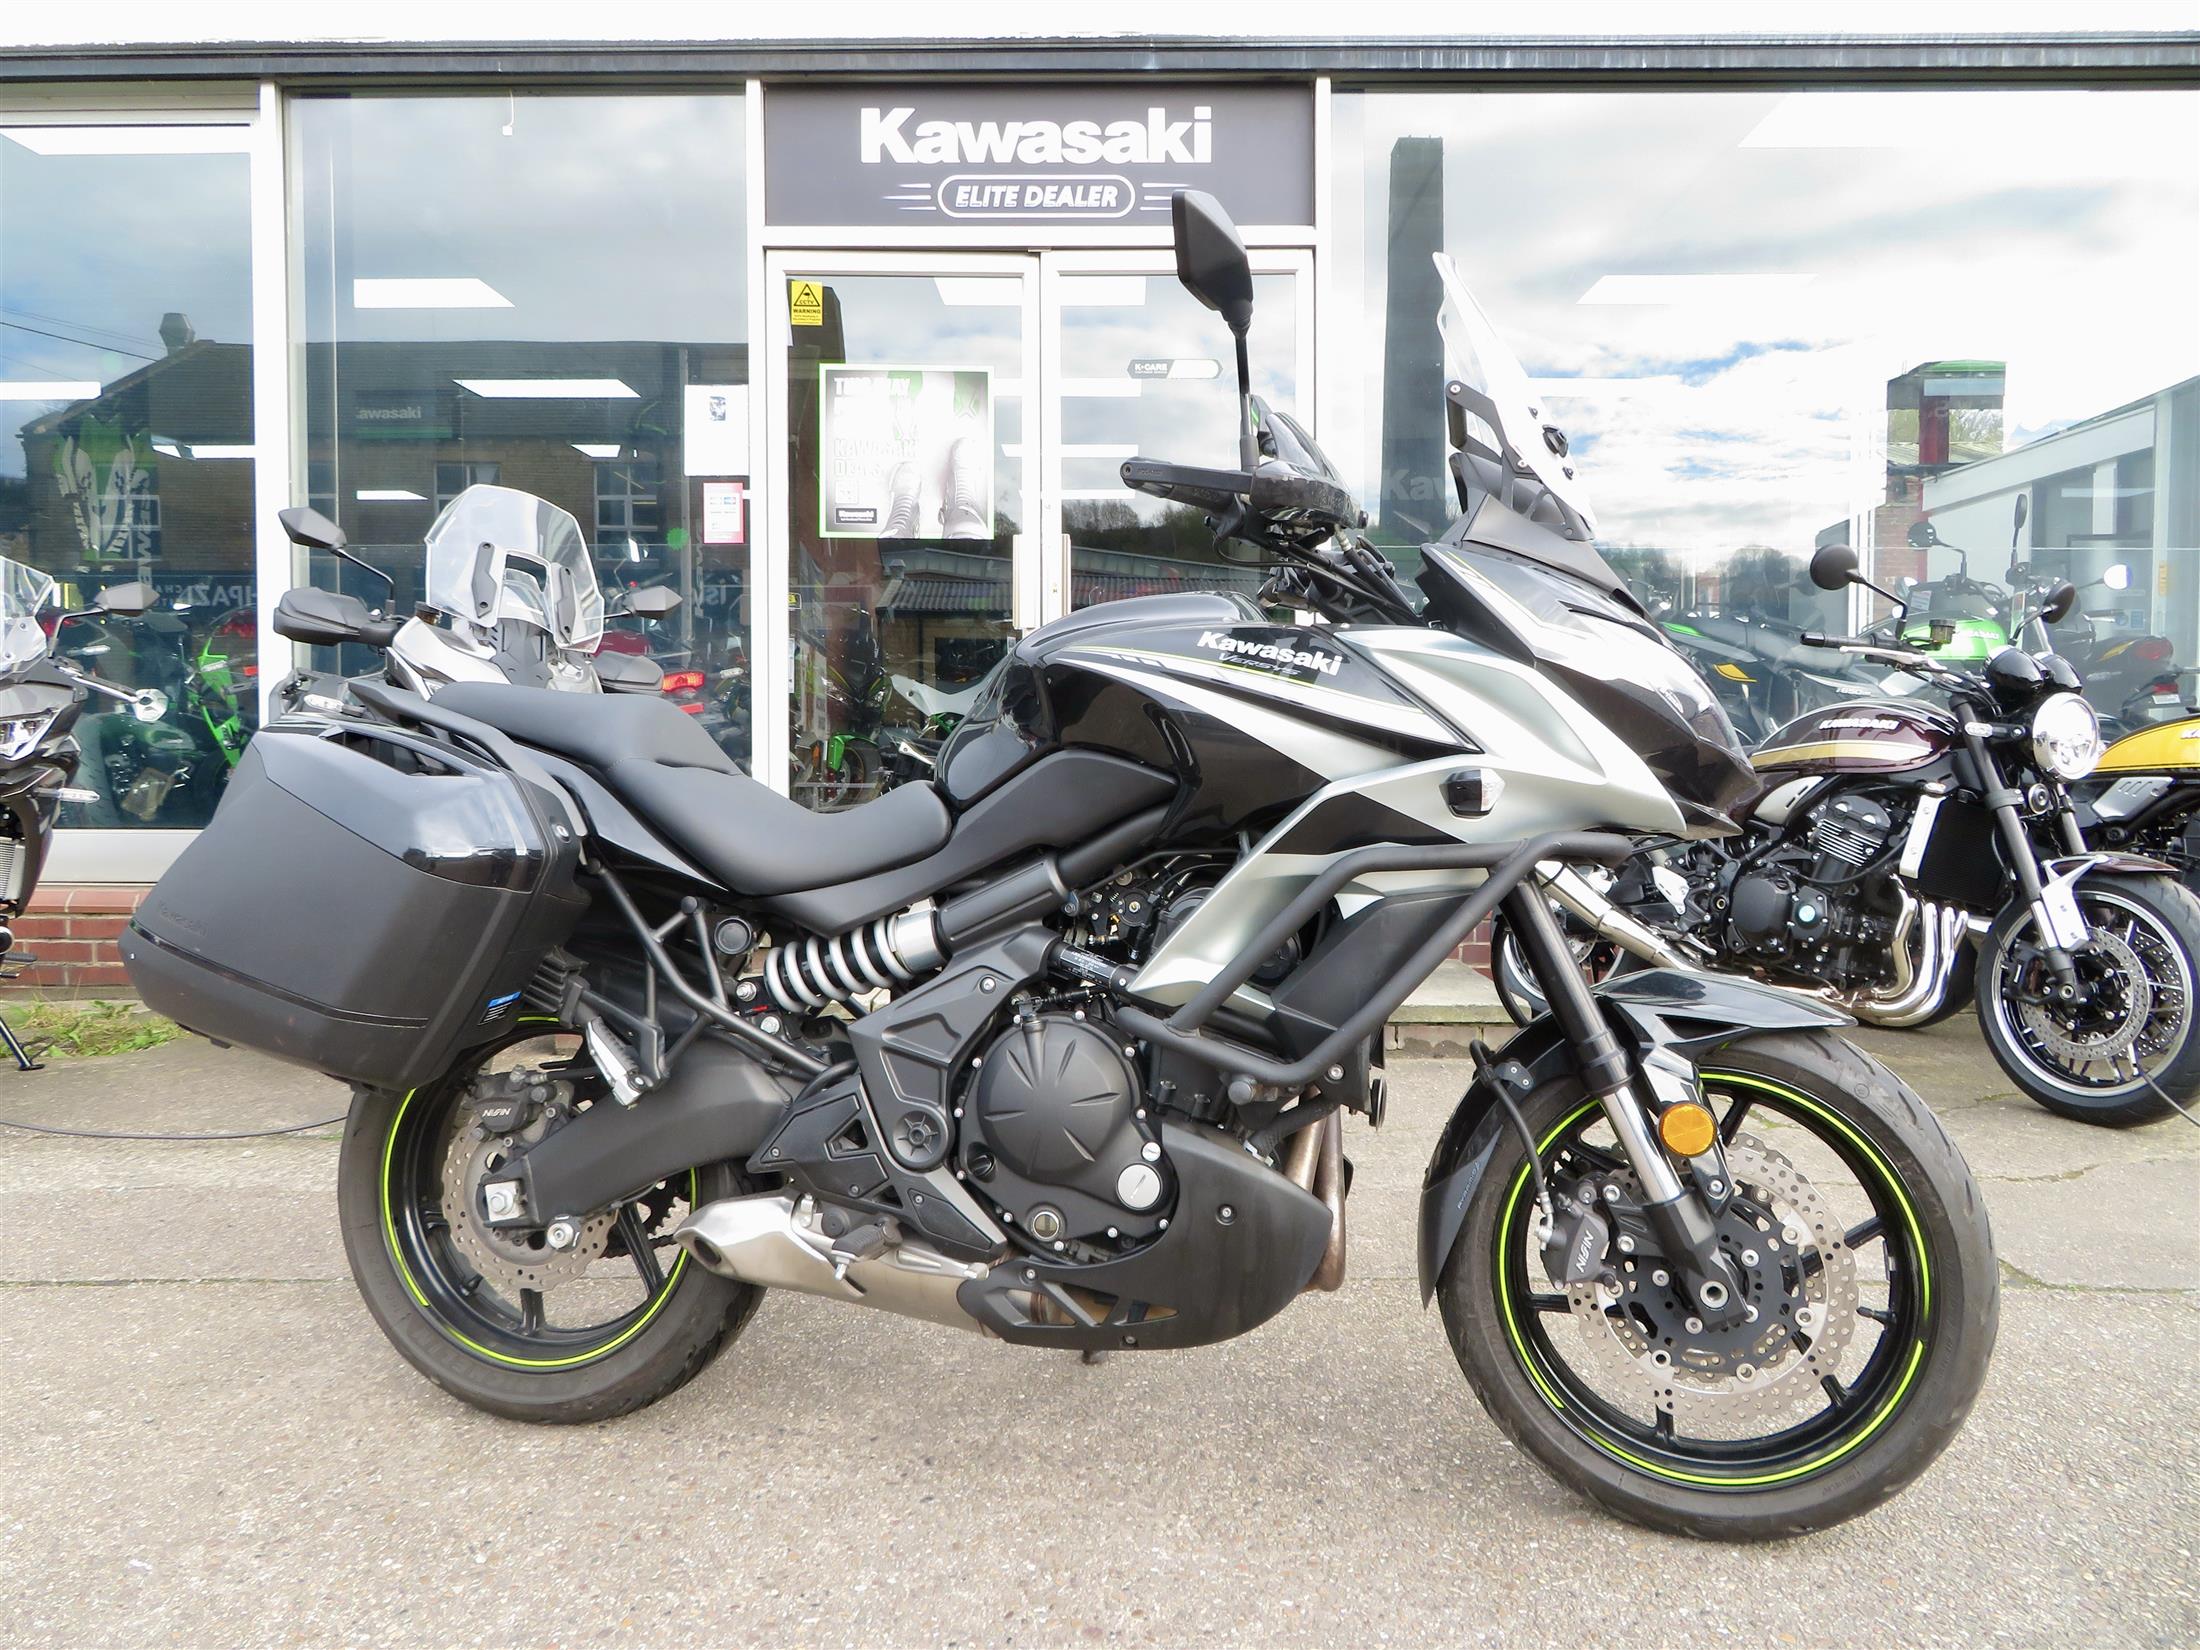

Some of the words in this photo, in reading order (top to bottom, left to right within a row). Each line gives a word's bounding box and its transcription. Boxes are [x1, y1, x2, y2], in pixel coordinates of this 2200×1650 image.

[860, 106, 1212, 164] Kawasaki
[955, 185, 1021, 207] ELITE
[1023, 185, 1119, 207] DEALER
[1197, 631, 1343, 676] Kawasaki
[1818, 718, 1901, 731] KAWASAKI
[1575, 1229, 1594, 1273] NISSIN
